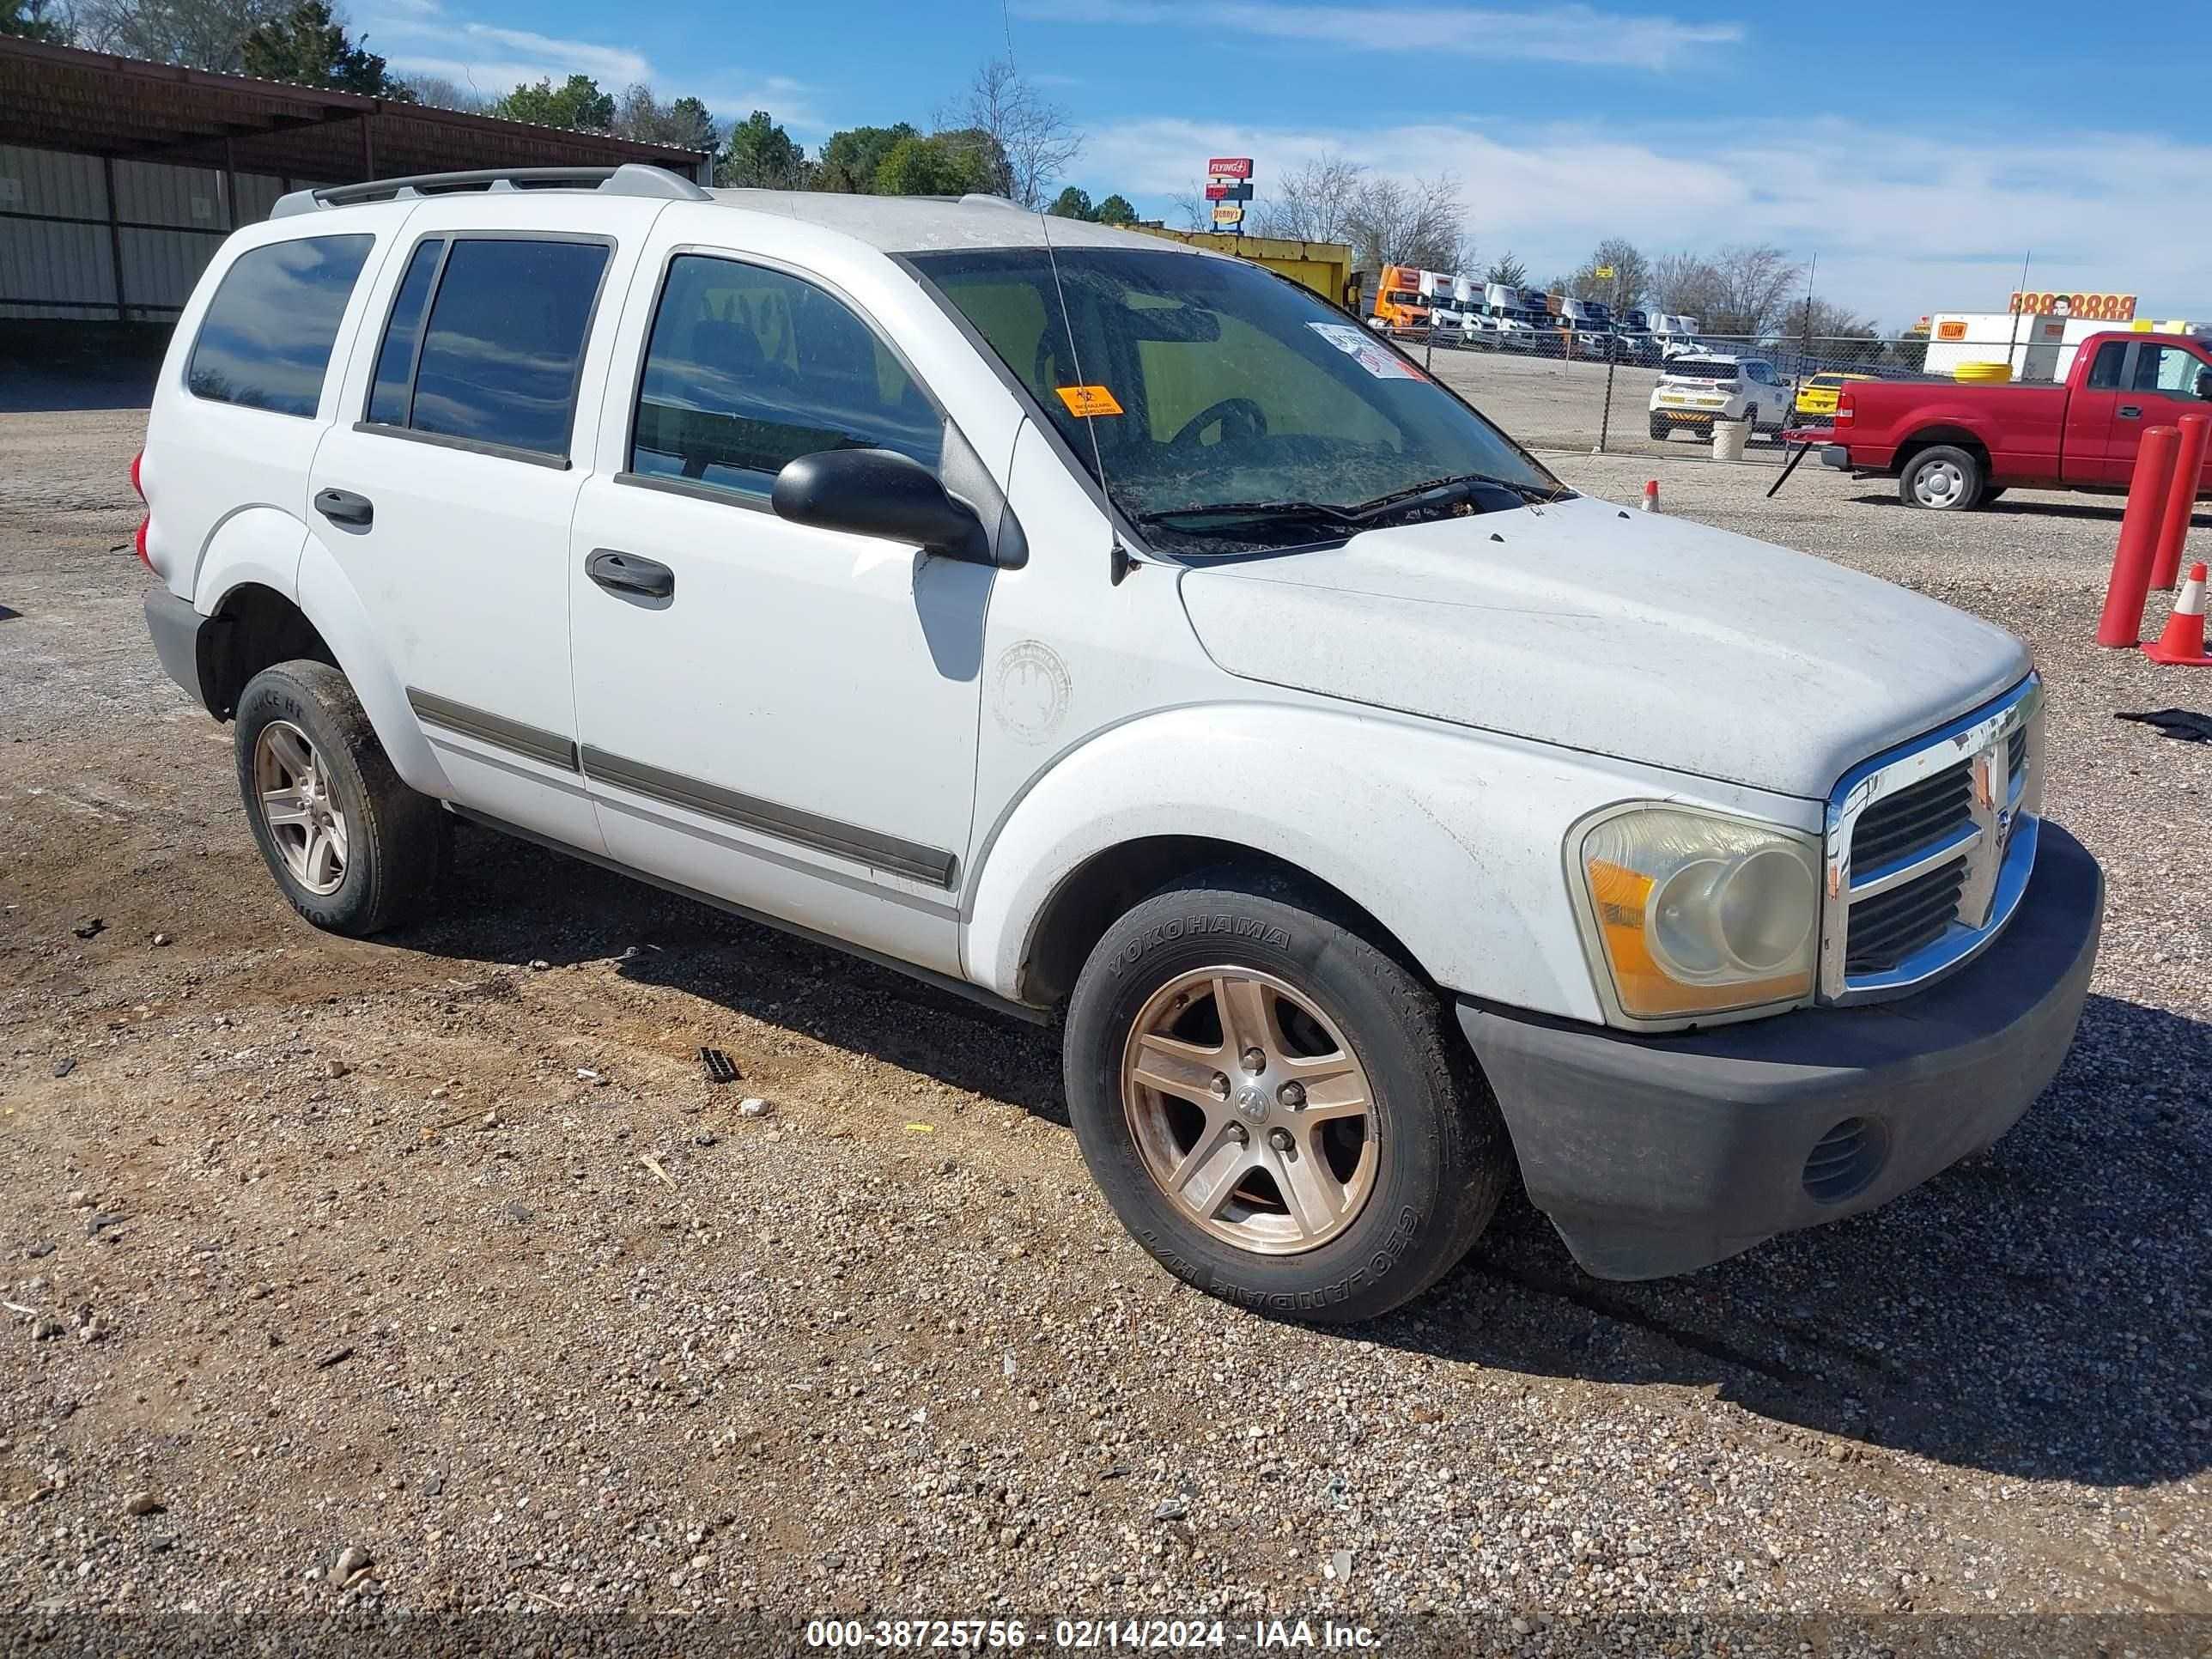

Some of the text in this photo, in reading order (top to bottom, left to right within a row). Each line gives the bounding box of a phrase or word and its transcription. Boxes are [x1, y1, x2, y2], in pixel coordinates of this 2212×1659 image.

[1211, 163, 1237, 173] FLYING
[1942, 324, 1964, 337] YELLOW
[1108, 913, 1291, 980] YOKOHAMA
